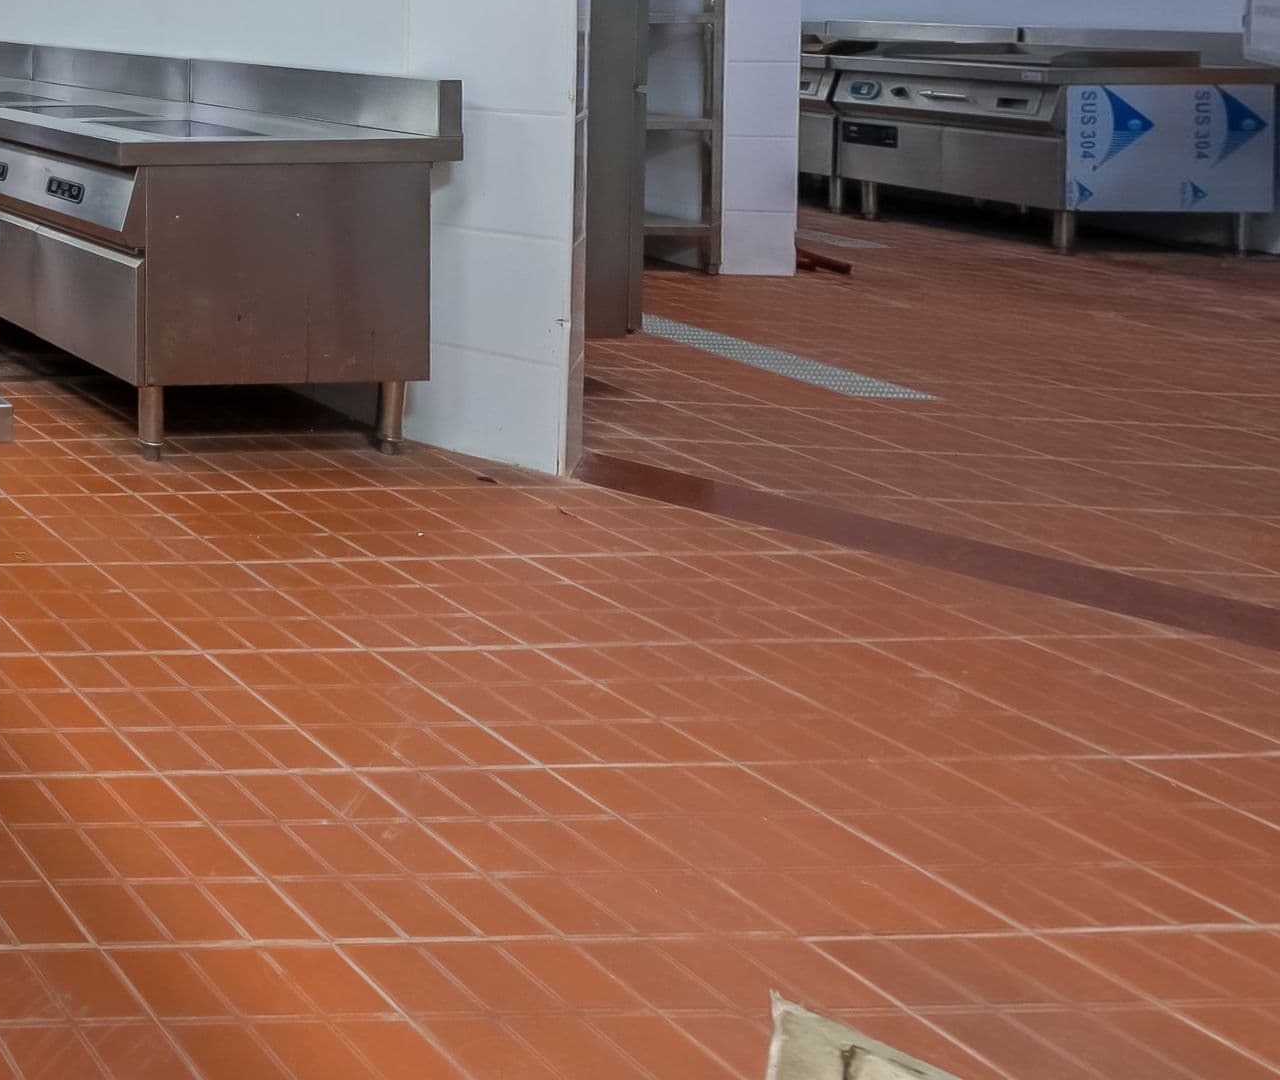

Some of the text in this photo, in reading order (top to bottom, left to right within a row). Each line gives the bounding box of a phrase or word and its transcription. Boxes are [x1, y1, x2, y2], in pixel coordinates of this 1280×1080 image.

[1079, 90, 1097, 159] SUS 304
[1194, 90, 1212, 126] SUS
